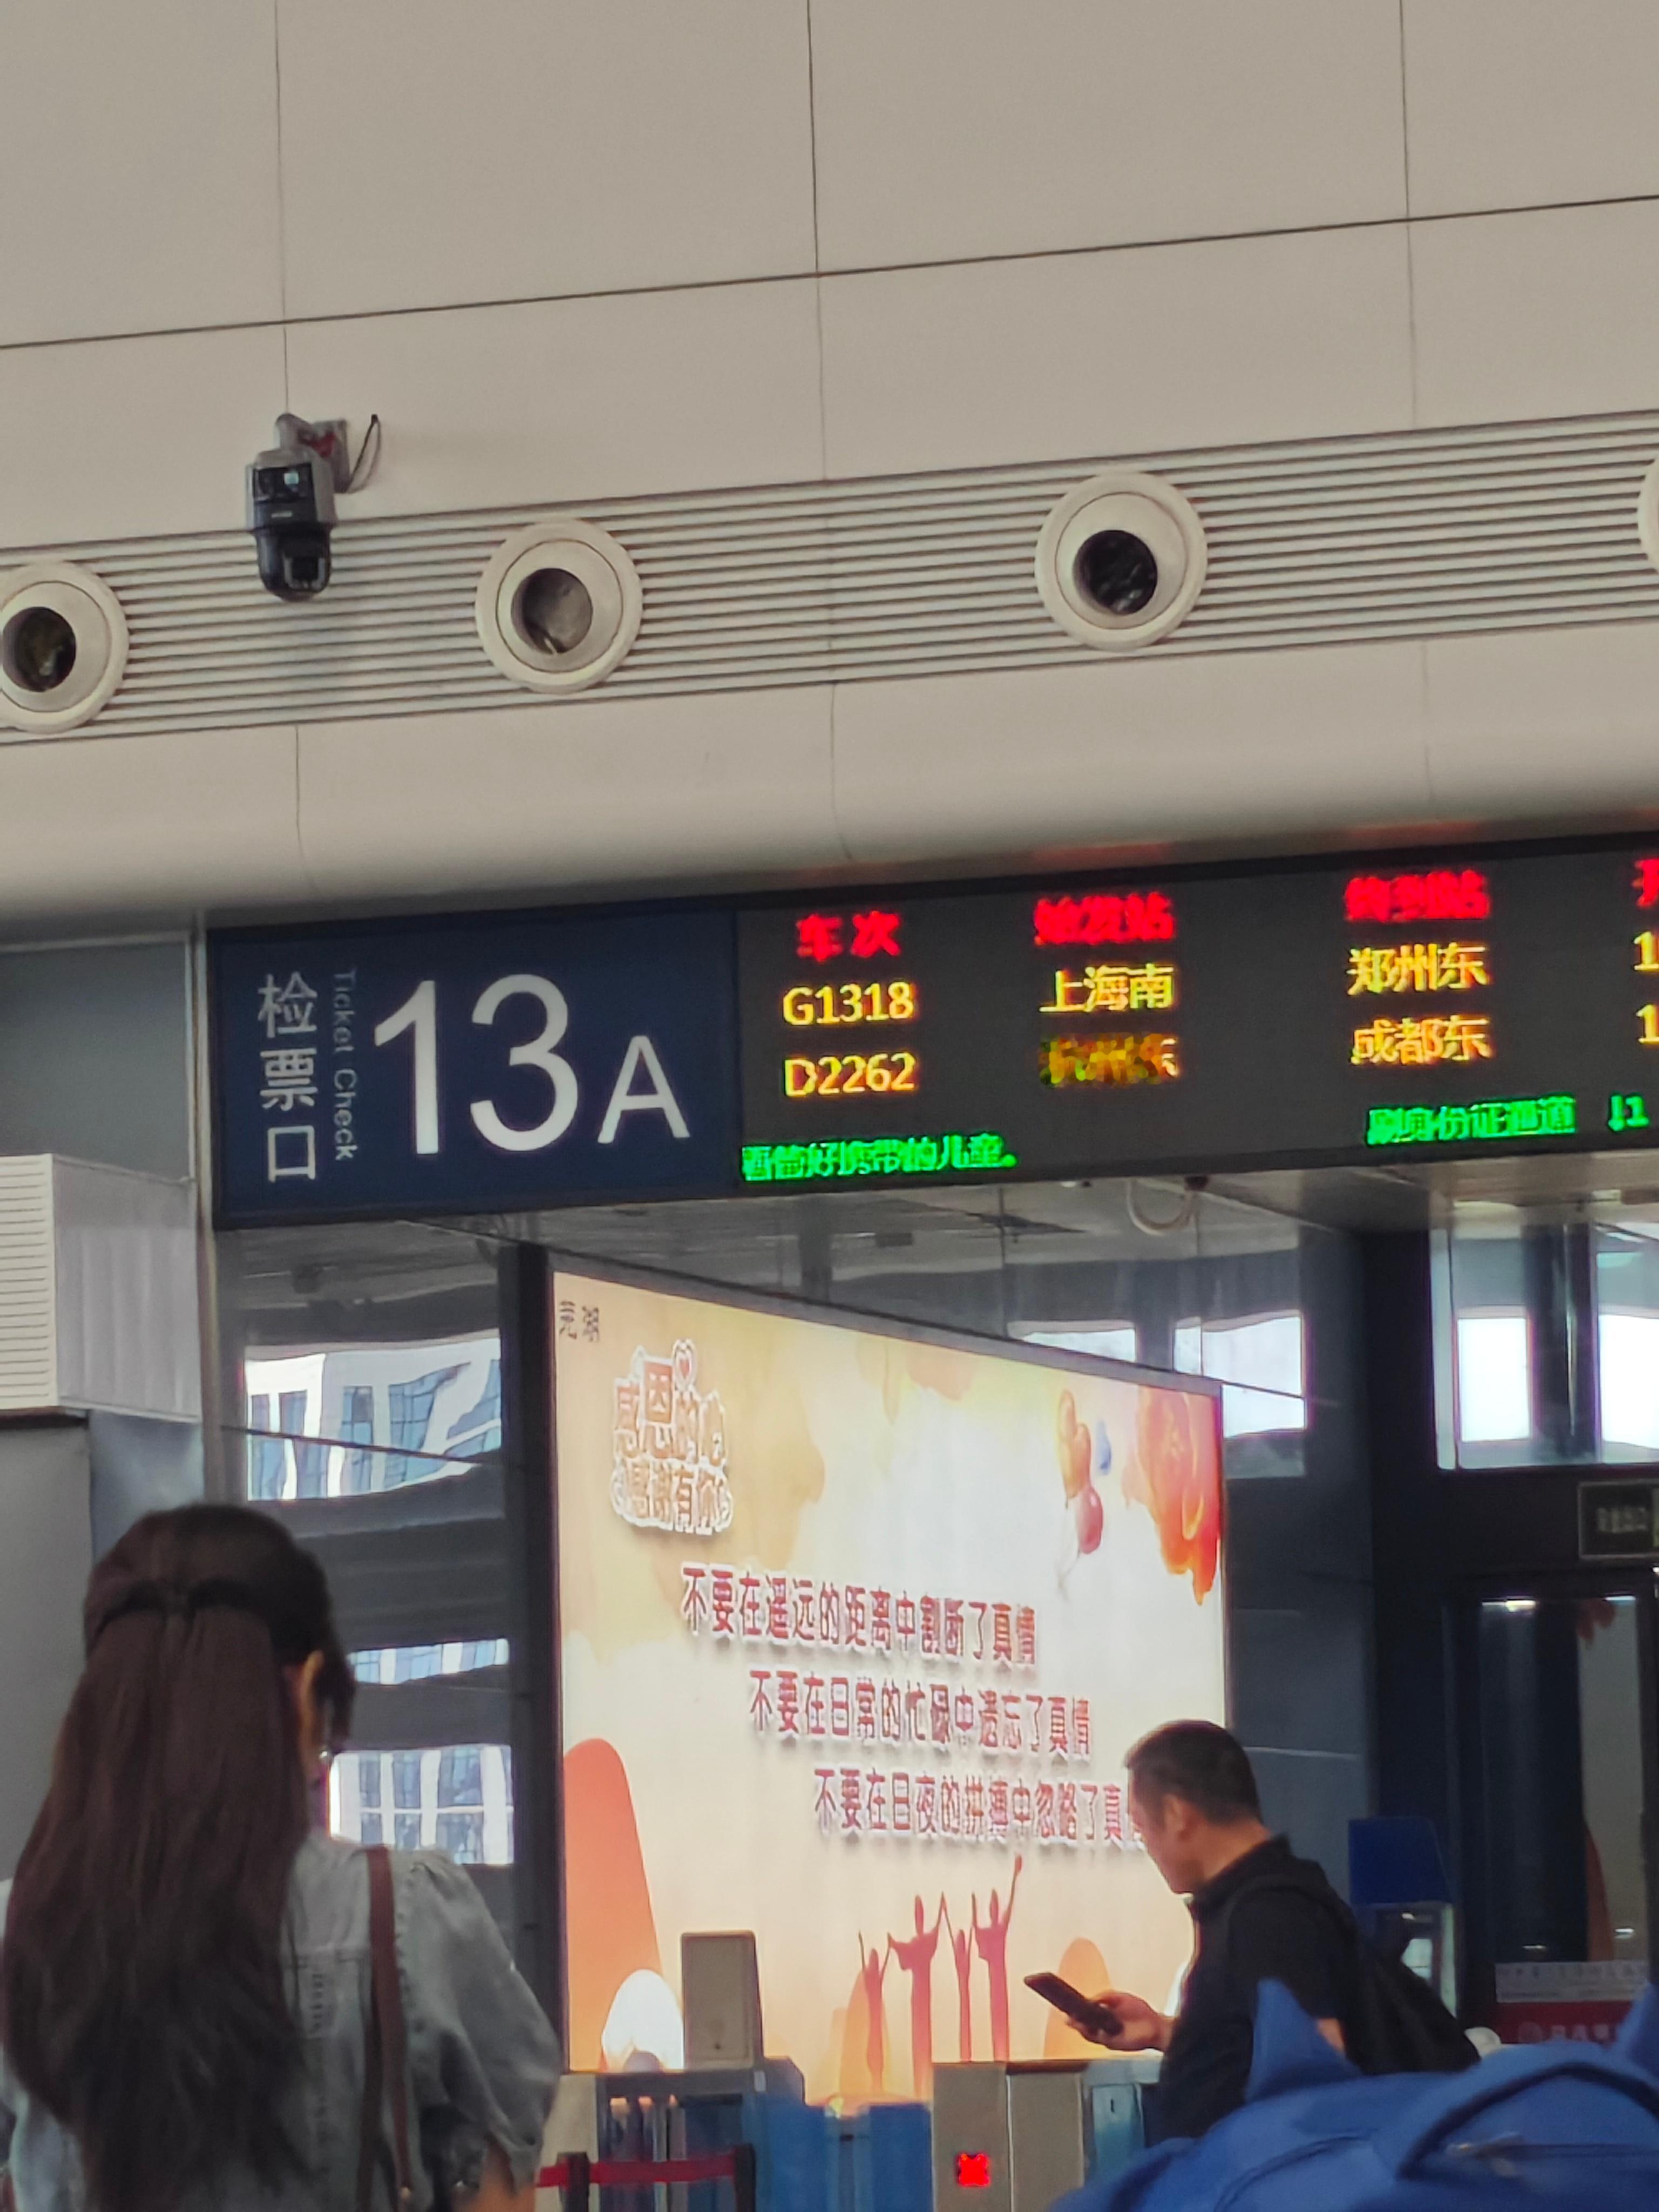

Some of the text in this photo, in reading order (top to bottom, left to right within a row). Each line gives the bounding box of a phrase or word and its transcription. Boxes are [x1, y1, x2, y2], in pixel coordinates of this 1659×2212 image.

[783, 981, 917, 1026] G1318
[1039, 963, 1176, 1013] 上海南
[1347, 942, 1491, 995] 郑州东
[259, 973, 318, 1183] 检票口
[333, 970, 358, 1161] Ticket Check
[785, 1051, 919, 1097] D2262
[1350, 1014, 1494, 1065] 成都东
[814, 1768, 1137, 1843] 不要在日夜的拼搏中忽略了真
